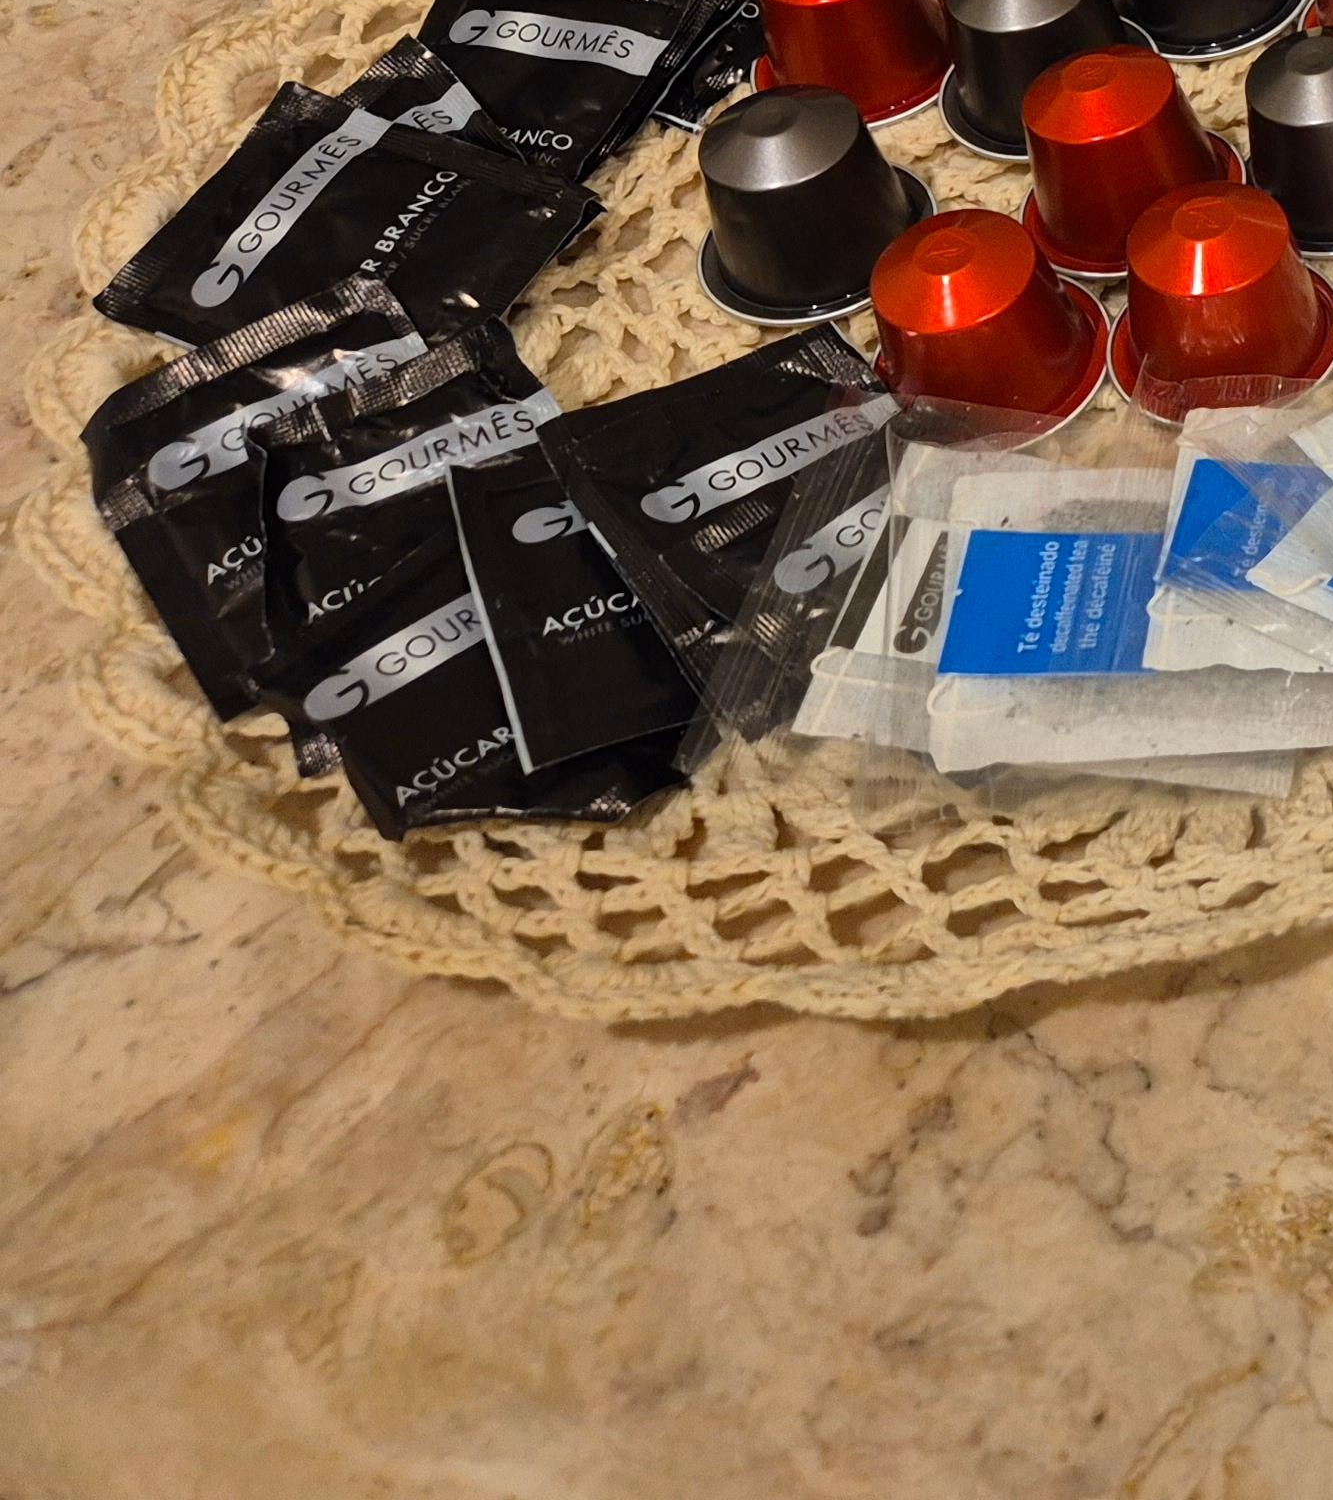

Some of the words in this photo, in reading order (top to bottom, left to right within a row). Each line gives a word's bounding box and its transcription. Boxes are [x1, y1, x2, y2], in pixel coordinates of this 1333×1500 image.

[497, 20, 634, 58] GOURMÊS
[238, 135, 361, 253] GOURMÊS
[374, 171, 459, 253] BRANCO
[349, 411, 534, 495] GOURMÊS
[708, 412, 874, 490] GOURMÊS
[1024, 541, 1060, 629] desteinado
[1050, 564, 1084, 654] decaffeinated
[376, 609, 481, 675] GOUR
[1016, 632, 1040, 653] Té
[396, 725, 514, 807] AÇÚCAR
